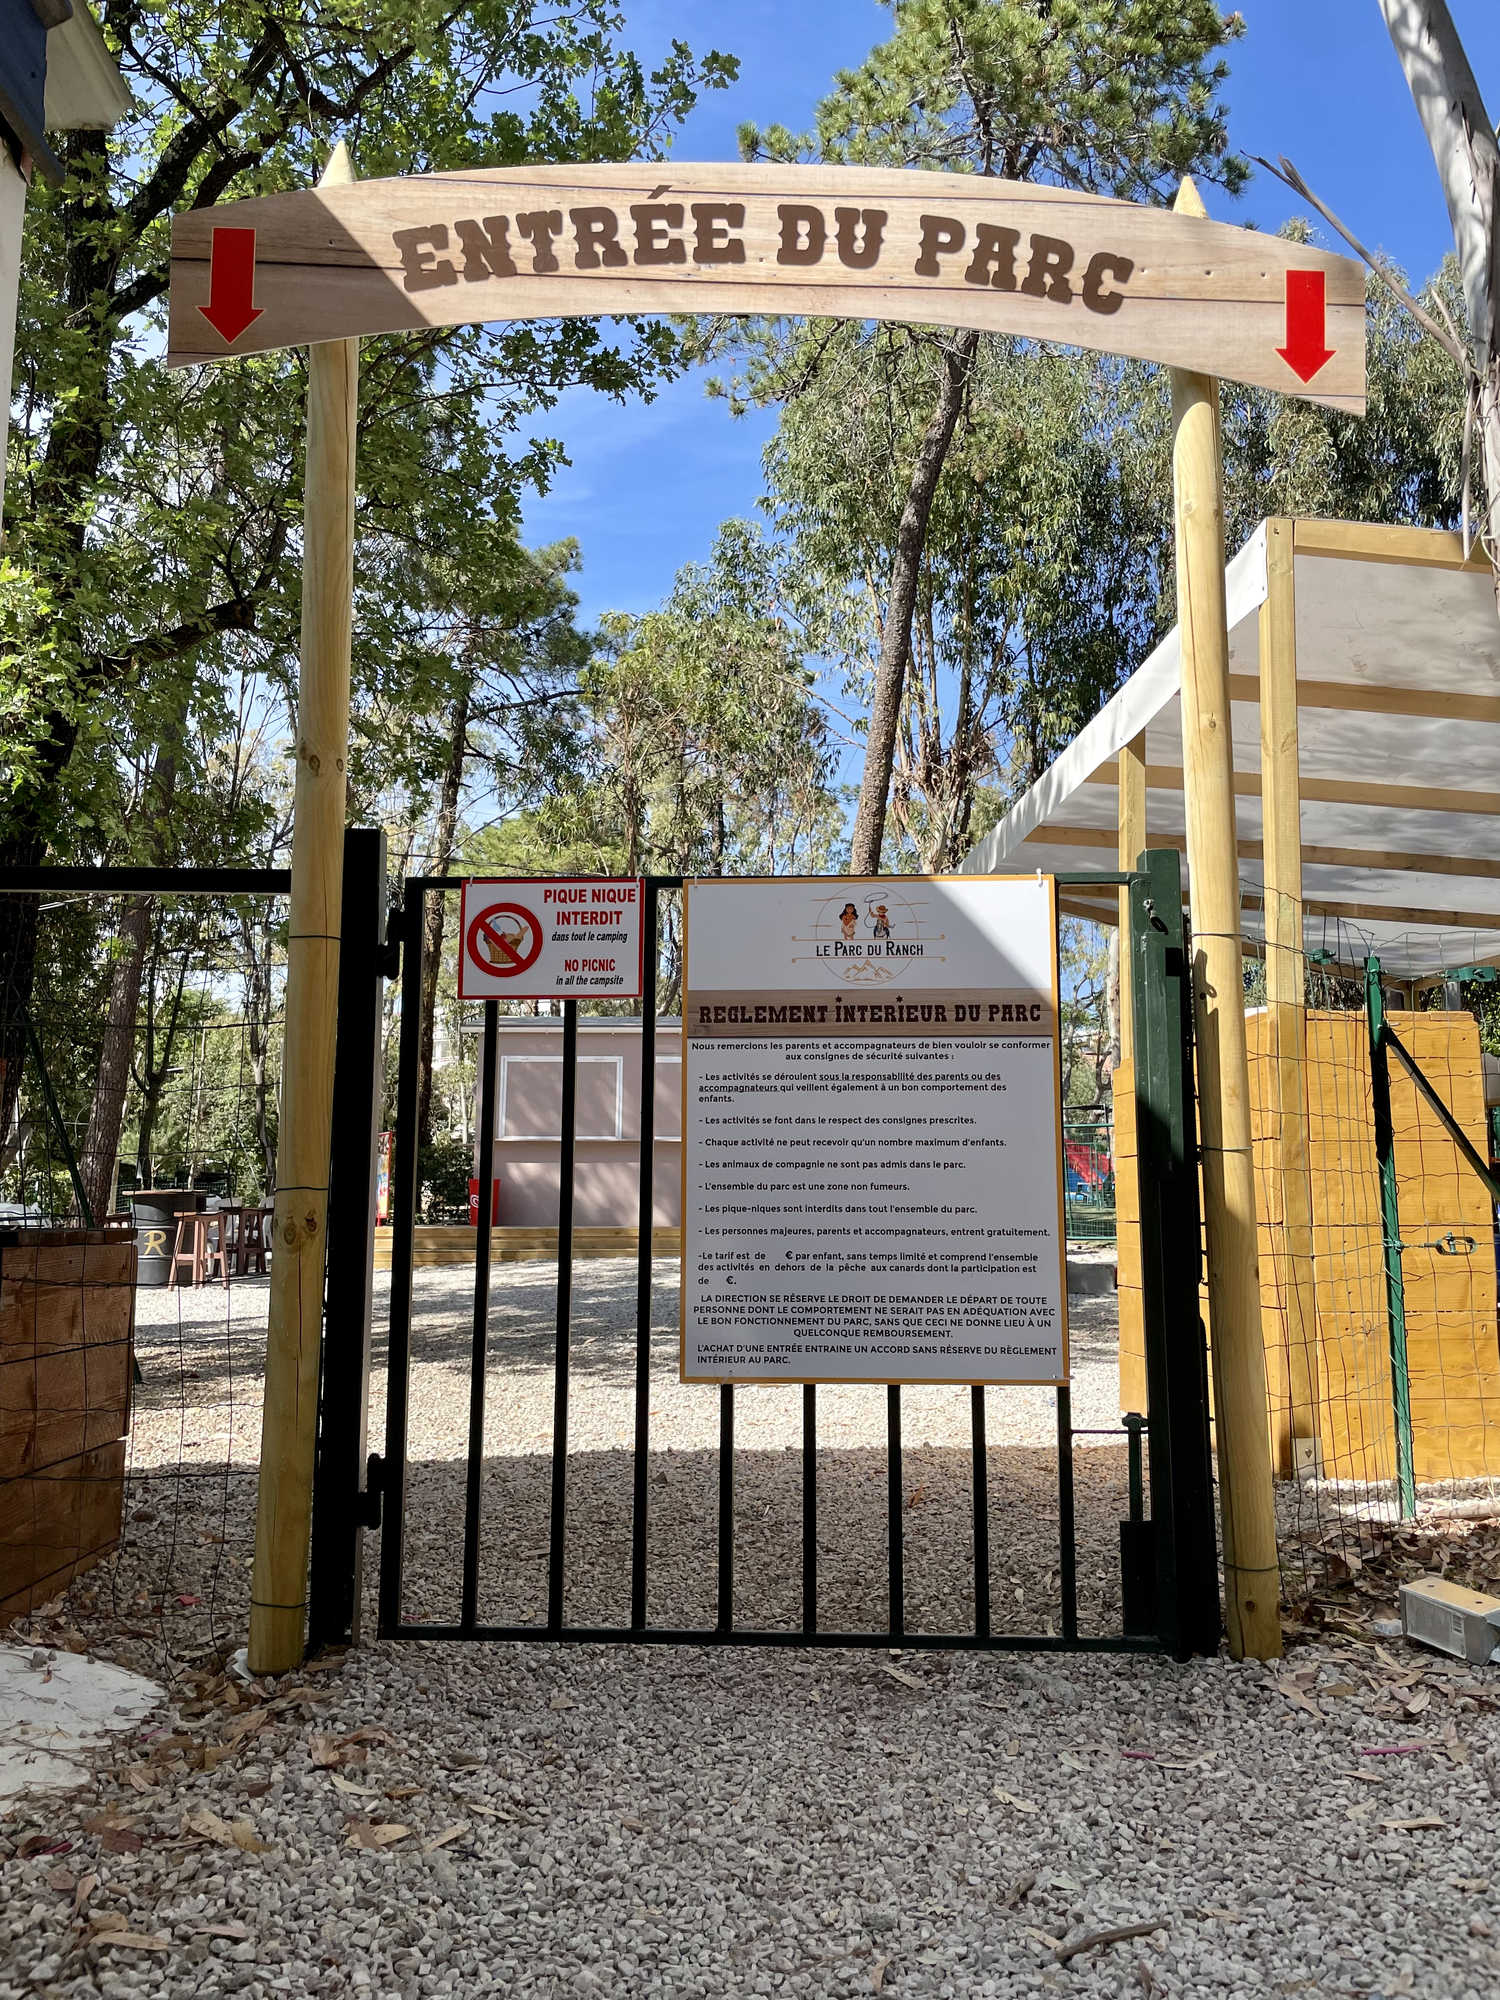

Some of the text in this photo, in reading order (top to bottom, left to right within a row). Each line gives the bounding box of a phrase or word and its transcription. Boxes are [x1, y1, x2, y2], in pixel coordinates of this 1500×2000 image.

[392, 184, 1134, 315] ENTRÉE DU PARC
[543, 887, 636, 904] PIQUE NIQUE
[556, 910, 623, 926] INTERDIT
[551, 930, 628, 943] dans tout le camping
[564, 958, 616, 972] NO PICNIC
[555, 974, 624, 988] in all the campsite
[698, 998, 1043, 1023] REGLEMENT INTERIEUR DU PARC
[691, 1042, 715, 1050] Nous
[716, 1041, 768, 1050] remercions
[769, 1041, 783, 1050] les
[784, 1041, 820, 1051] parents
[821, 1041, 832, 1050] et
[833, 1041, 916, 1051] accompagnateurs
[917, 1040, 930, 1049] de
[931, 1040, 953, 1049] bien
[953, 1040, 987, 1049] vouloir
[1000, 1040, 1050, 1049] conformer
[803, 1051, 850, 1062] consignes
[851, 1051, 864, 1060] de
[865, 1051, 903, 1060] sécurité
[904, 1051, 949, 1060] suivantes
[704, 1116, 720, 1124] Les
[721, 1115, 760, 1124] activités
[773, 1115, 793, 1124] font
[794, 1115, 816, 1124] dans
[817, 1115, 826, 1124] le
[827, 1116, 862, 1126] respect
[863, 1115, 880, 1124] des
[881, 1115, 927, 1126] consignes
[928, 1115, 977, 1126] prescrites.
[704, 1137, 739, 1148] Chaque
[740, 1137, 774, 1146] activité
[789, 1138, 811, 1148] peut
[812, 1137, 849, 1146] recevoir
[850, 1137, 876, 1148] qu'un
[877, 1137, 913, 1146] nombre
[914, 1137, 960, 1147] maximum
[961, 1137, 1007, 1147] d'enfants.
[704, 1160, 720, 1168] Les
[721, 1159, 760, 1168] animaux
[761, 1159, 773, 1168] de
[774, 1159, 825, 1170] compagnie
[839, 1160, 860, 1168] sont
[861, 1161, 878, 1170] pas
[879, 1159, 907, 1168] admis
[908, 1160, 931, 1168] dans
[932, 1160, 941, 1168] le
[942, 1161, 966, 1170] parc.
[704, 1181, 910, 1192] L'ensemble du parc est une zone non fumeurs.
[704, 1203, 977, 1215] Les pique-niques sont interdits dans tout l'ensemble du parc.
[704, 1226, 1050, 1238] Les personnes majeures, parents et accompagnateurs, entrent gratuitement.
[143, 1229, 167, 1256] R
[697, 1276, 709, 1285] de
[700, 1293, 1047, 1305] LA DIRECTION SE RÉSERVE LE DROIT DE DEMANDER LE DÉPART DE TOUTE
[692, 1305, 1055, 1317] PERSONNE DONT LE COMPORTEMENT NE SERAIT PAS EN ADÉQUATION AVEC
[697, 1316, 1051, 1327] LE BON FONCTIONNEMENT DU PARC, SANS QUE CECI NE DONNE LIEU À UN
[793, 1328, 953, 1338] QUELCONQUE REMBOURSEMENT.
[697, 1343, 1057, 1356] L'ACHAT D'UNE ENTRÉE ENTRAINE UN ACCORD SANS RÉSERVE DU RÈGLEMENT
[696, 1353, 791, 1364] INTÉRIEUR AU PARC.
